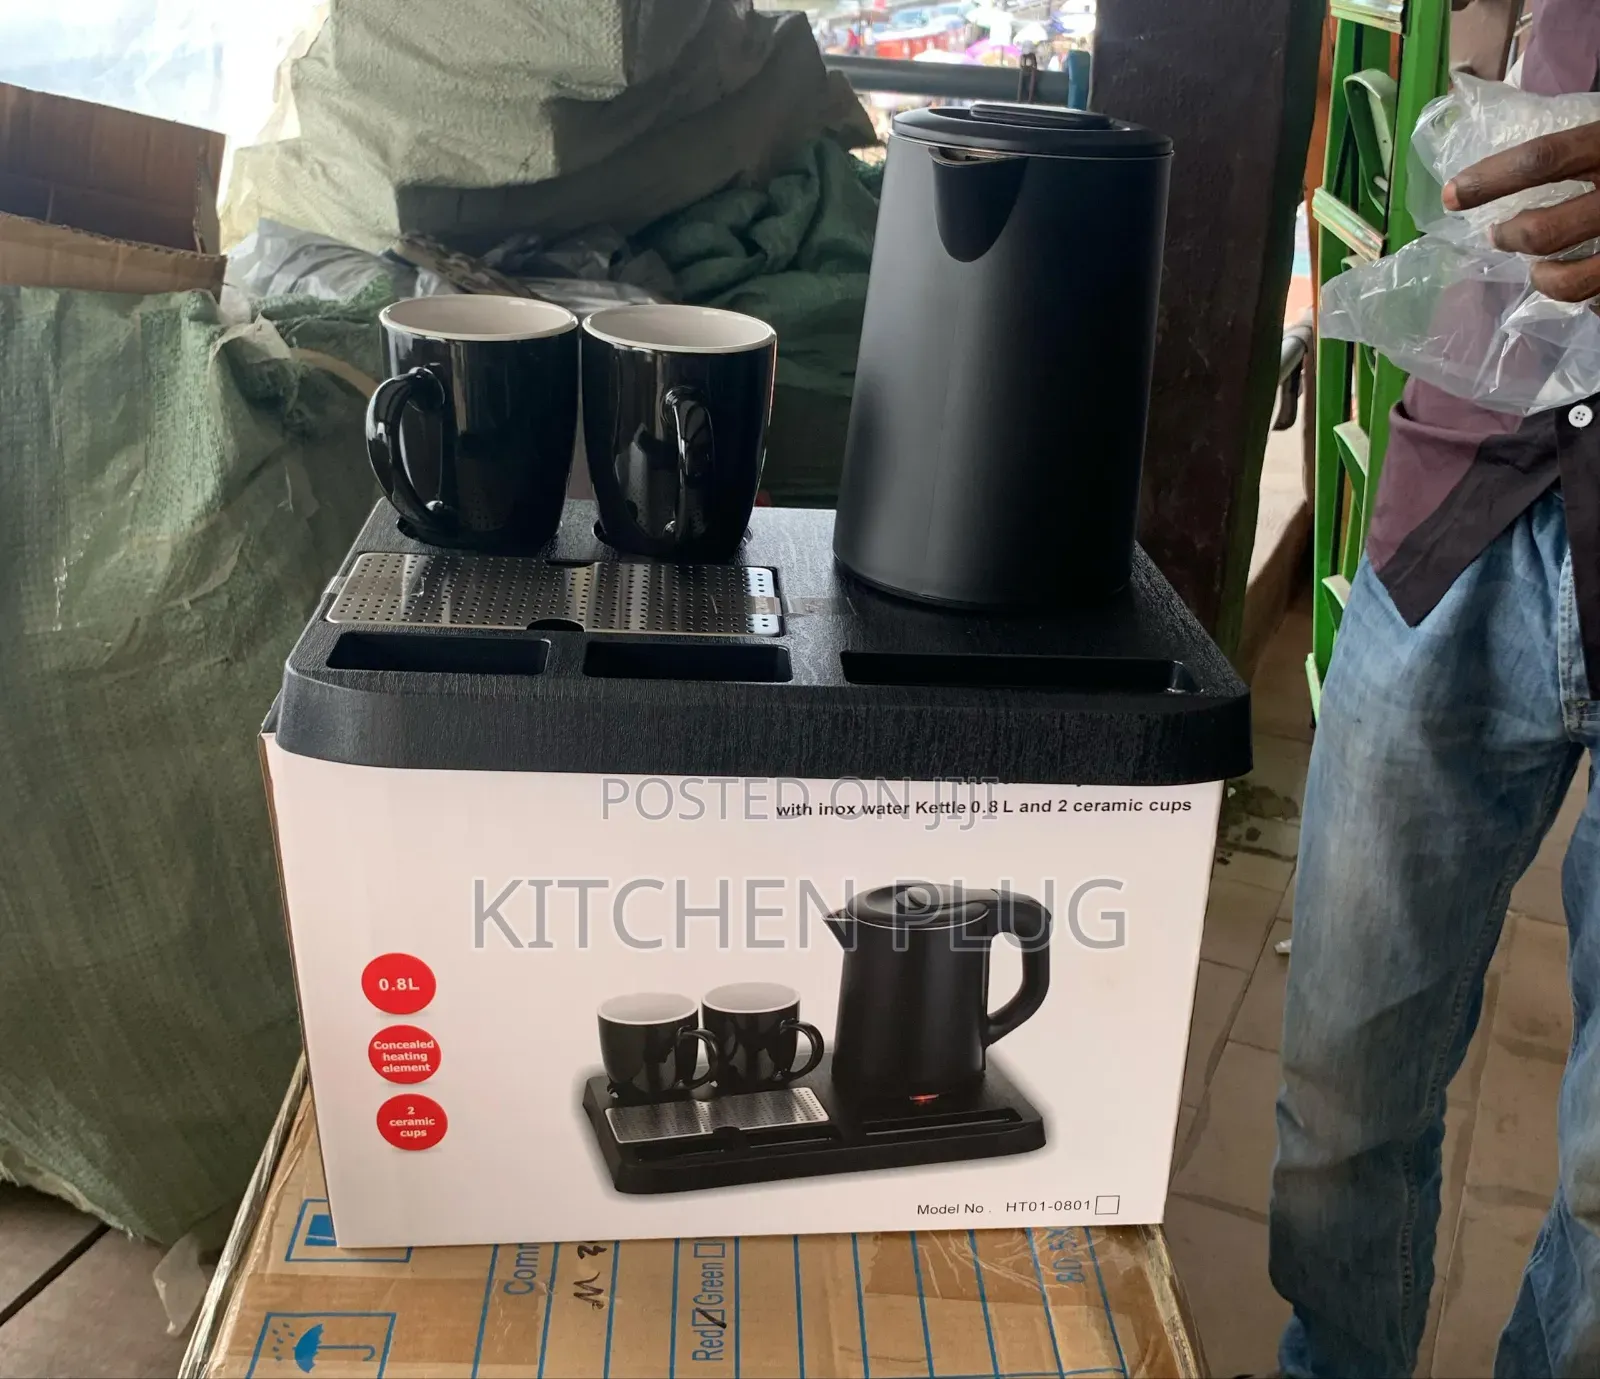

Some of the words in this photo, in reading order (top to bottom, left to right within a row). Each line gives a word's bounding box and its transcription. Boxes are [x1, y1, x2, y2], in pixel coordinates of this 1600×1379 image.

[776, 803, 812, 816] with
[819, 802, 855, 816] inox
[862, 801, 910, 815] water
[916, 801, 966, 815] Kettle
[1019, 800, 1052, 813] and
[1058, 800, 1068, 813] 2
[1073, 798, 1143, 813] ceramic
[1149, 800, 1192, 814] cups
[378, 977, 420, 991] 0.8L
[373, 1039, 434, 1050] Concealed
[382, 1052, 428, 1063] heating
[382, 1063, 431, 1073] element
[407, 1106, 415, 1115] 2
[389, 1117, 435, 1127] ceramic
[400, 1128, 427, 1139] cups
[917, 1204, 960, 1215] Model
[1006, 1200, 1091, 1213] HT01-0801
[692, 1262, 725, 1306] Green
[691, 1330, 725, 1361] Red
